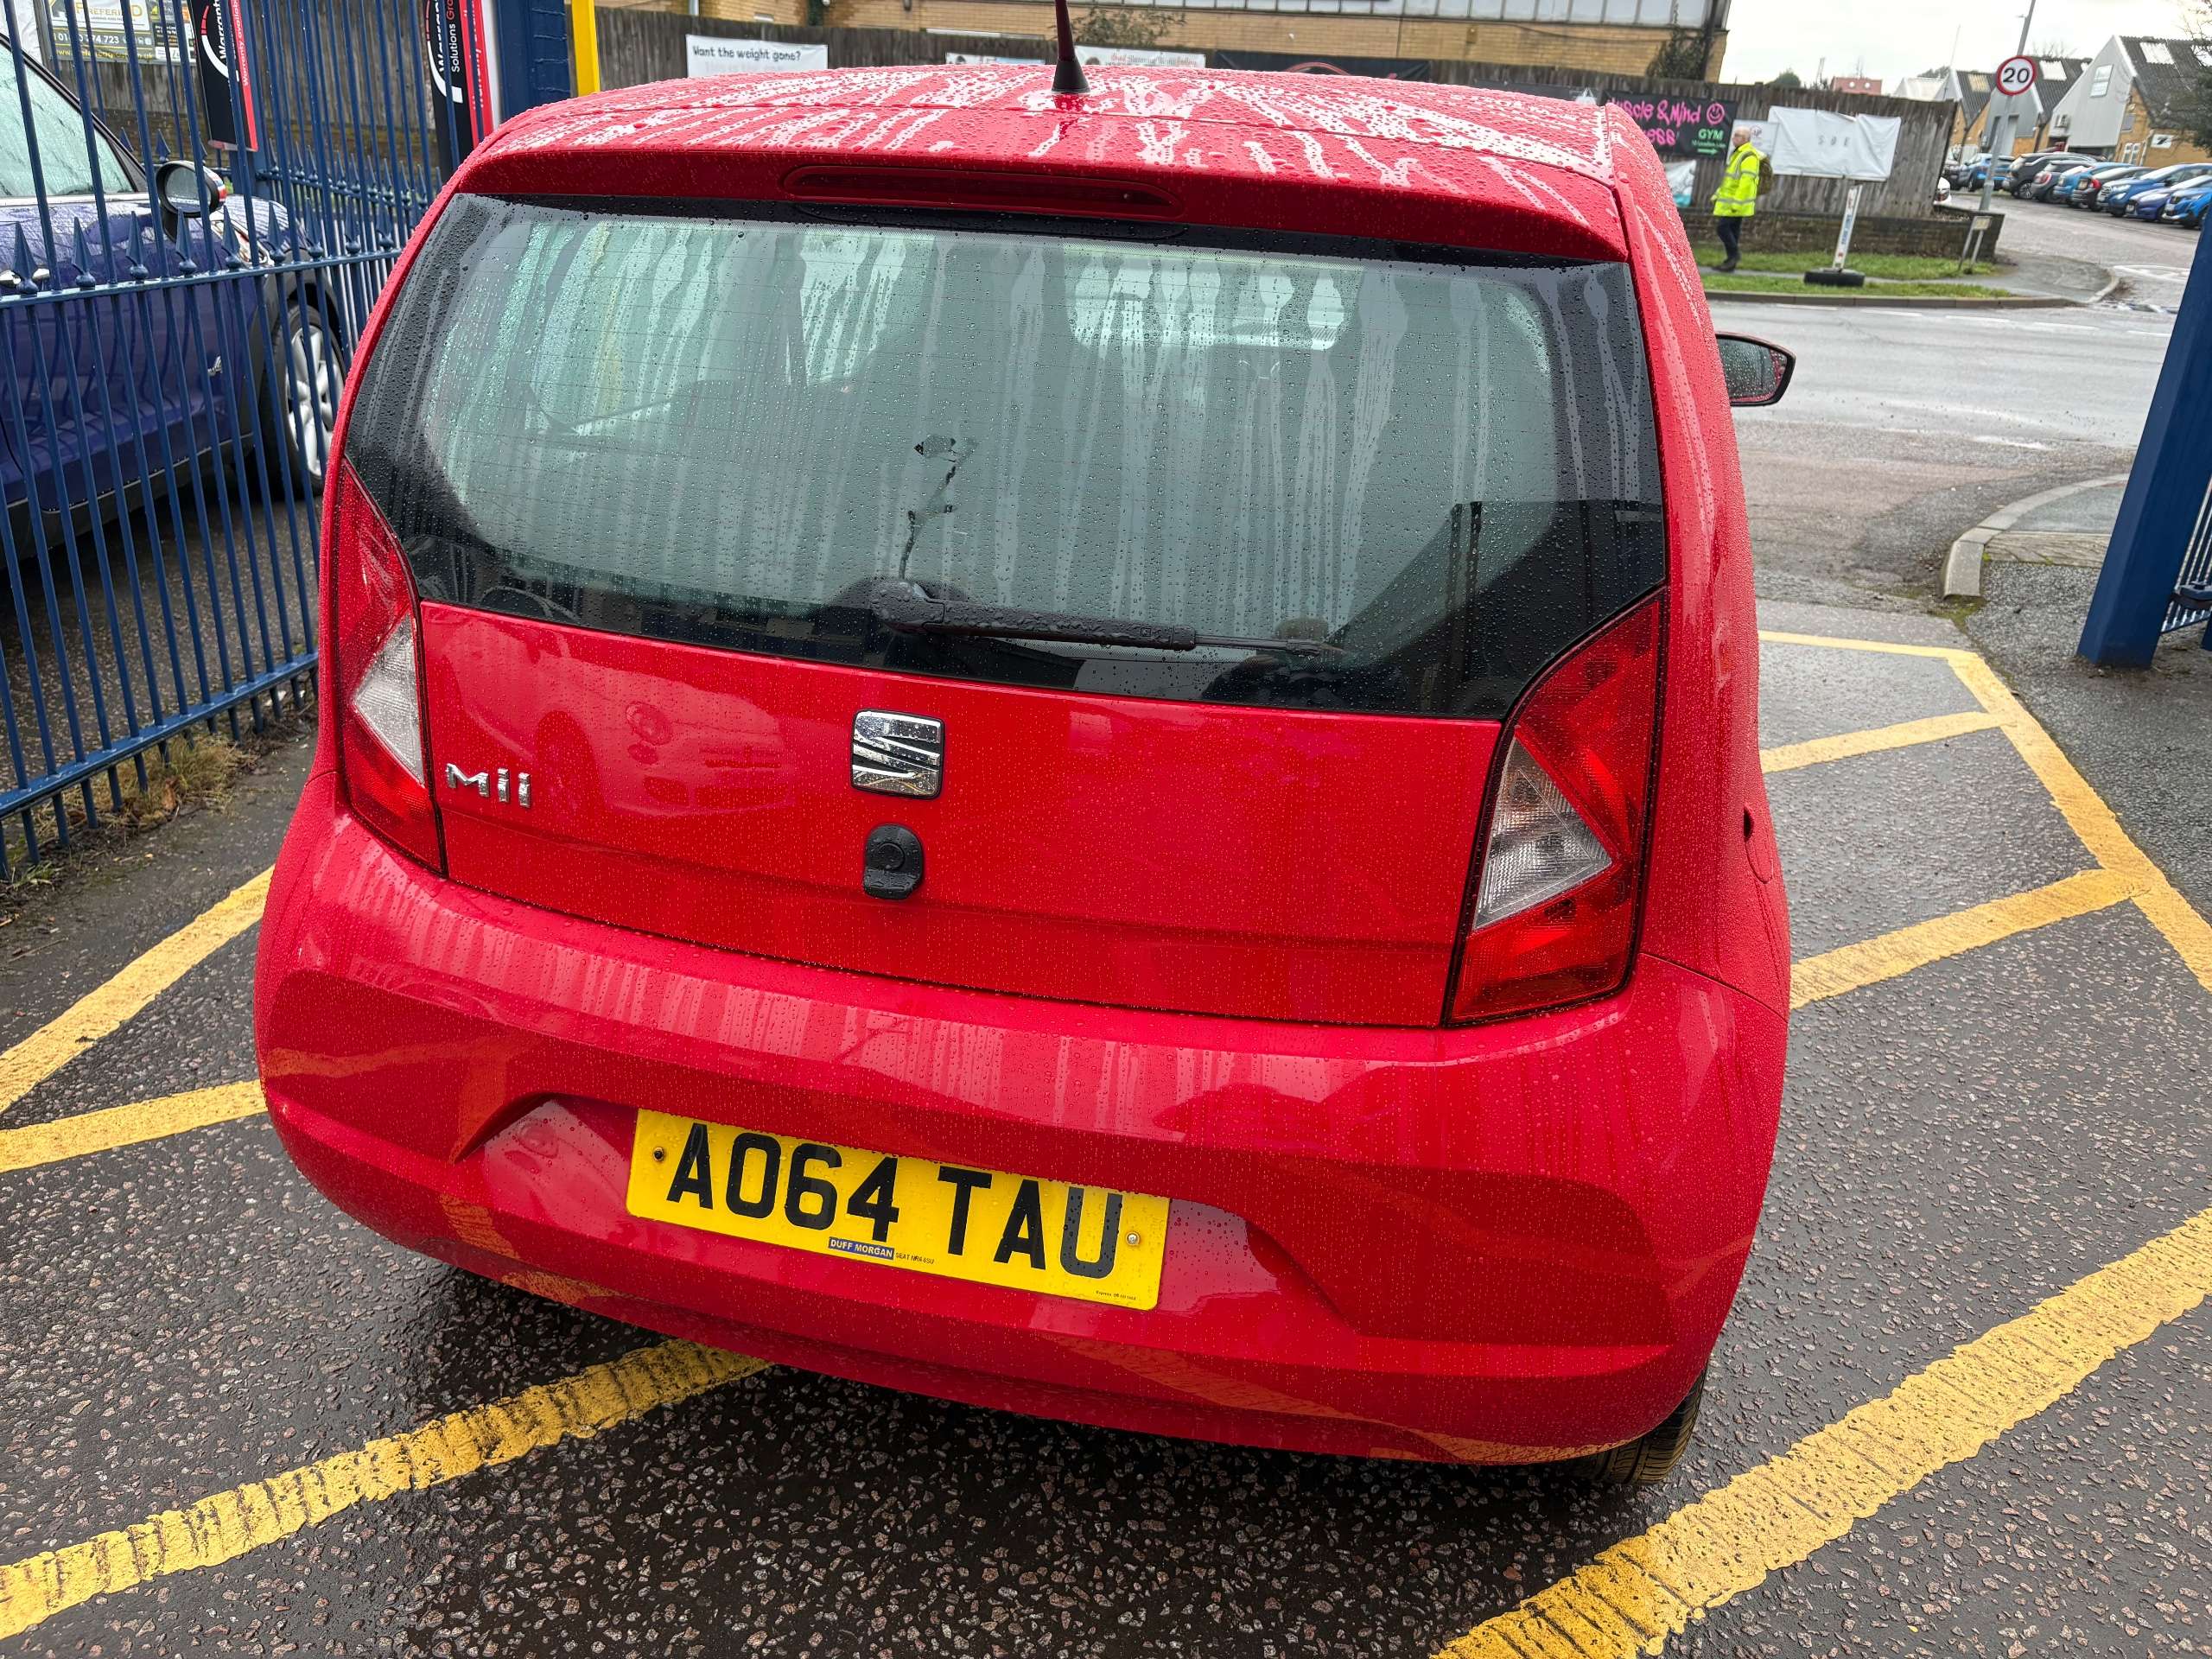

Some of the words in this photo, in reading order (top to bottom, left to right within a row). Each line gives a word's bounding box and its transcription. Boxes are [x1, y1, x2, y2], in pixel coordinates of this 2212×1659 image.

[239, 41, 250, 86] Warranty
[449, 23, 461, 73] Solutions
[693, 46, 715, 56] Want
[718, 48, 734, 58] the
[736, 50, 770, 61] weight
[772, 51, 801, 62] gone?
[2003, 67, 2030, 83] 20
[1698, 128, 1724, 141] GYM
[445, 763, 531, 808] Mii
[666, 1123, 899, 1243] AO64
[938, 1165, 1123, 1279] TAU
[830, 1239, 854, 1250] DUFF
[855, 1243, 893, 1258] MORGAN
[895, 1252, 911, 1261] SEAT
